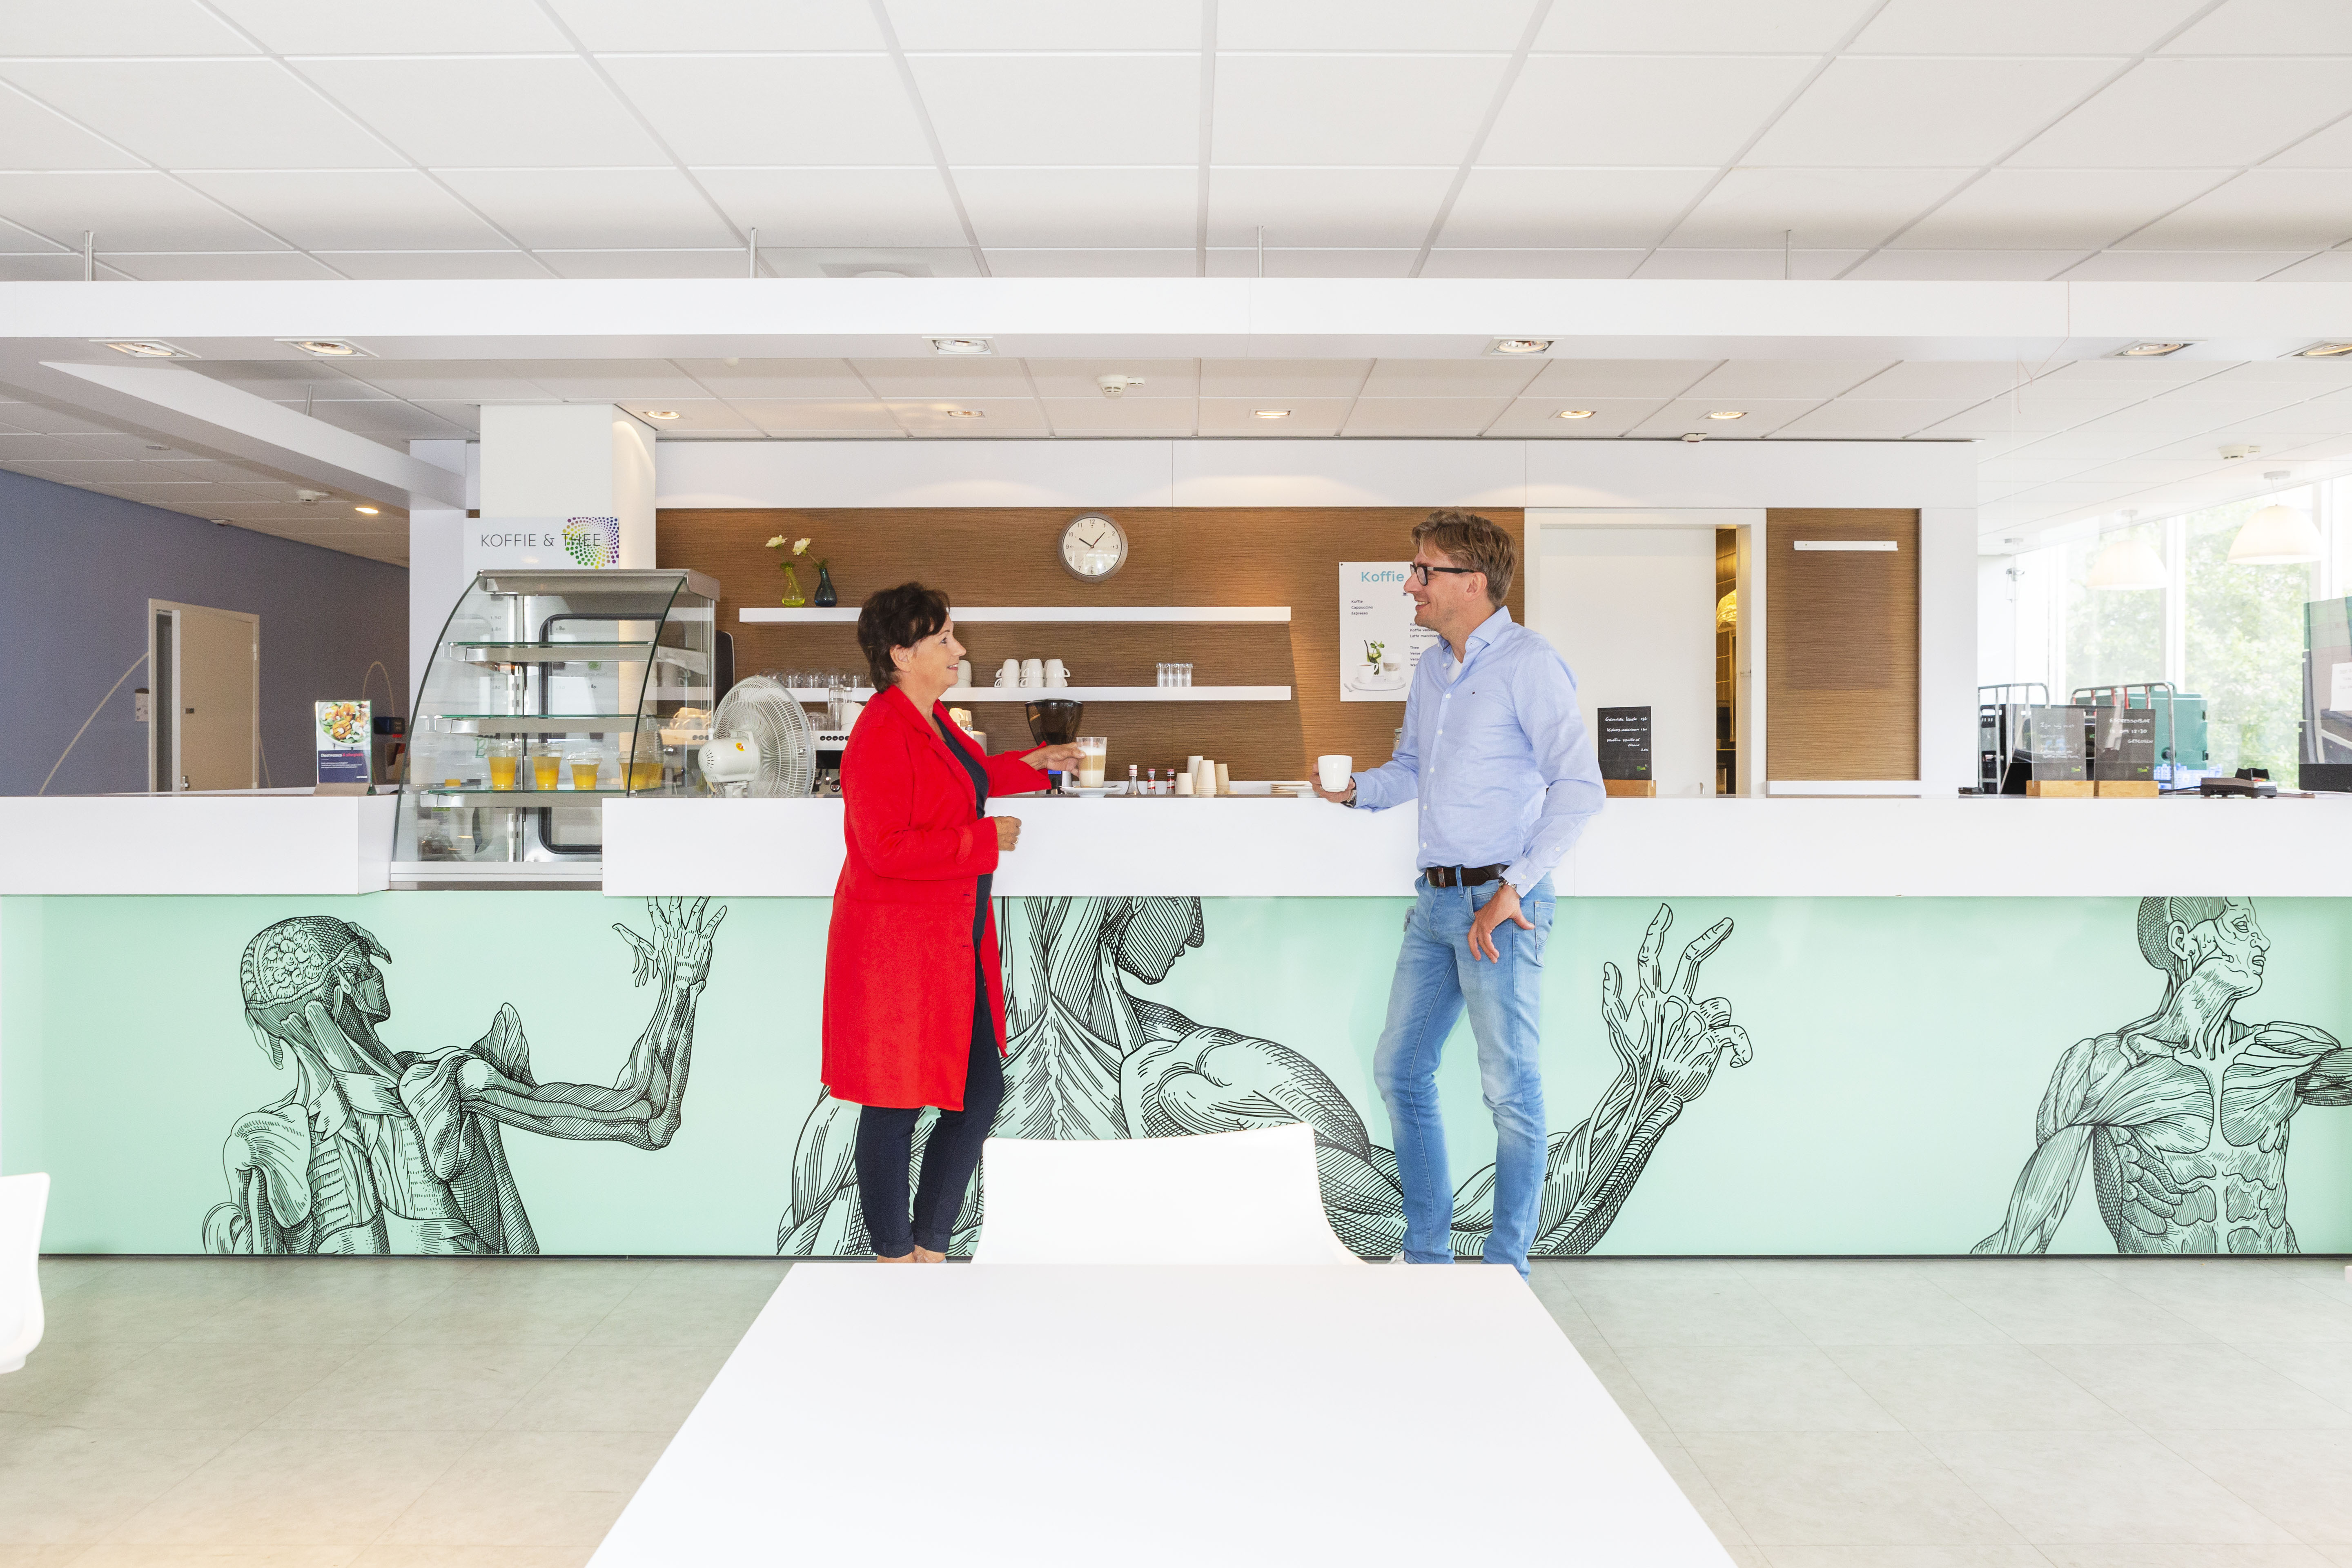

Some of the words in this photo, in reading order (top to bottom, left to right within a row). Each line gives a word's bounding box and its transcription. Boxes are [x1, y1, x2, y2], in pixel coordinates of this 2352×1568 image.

[481, 534, 536, 547] KOFFIE
[543, 534, 555, 546] &
[561, 533, 601, 546] THEE
[1361, 571, 1405, 582] Koffie
